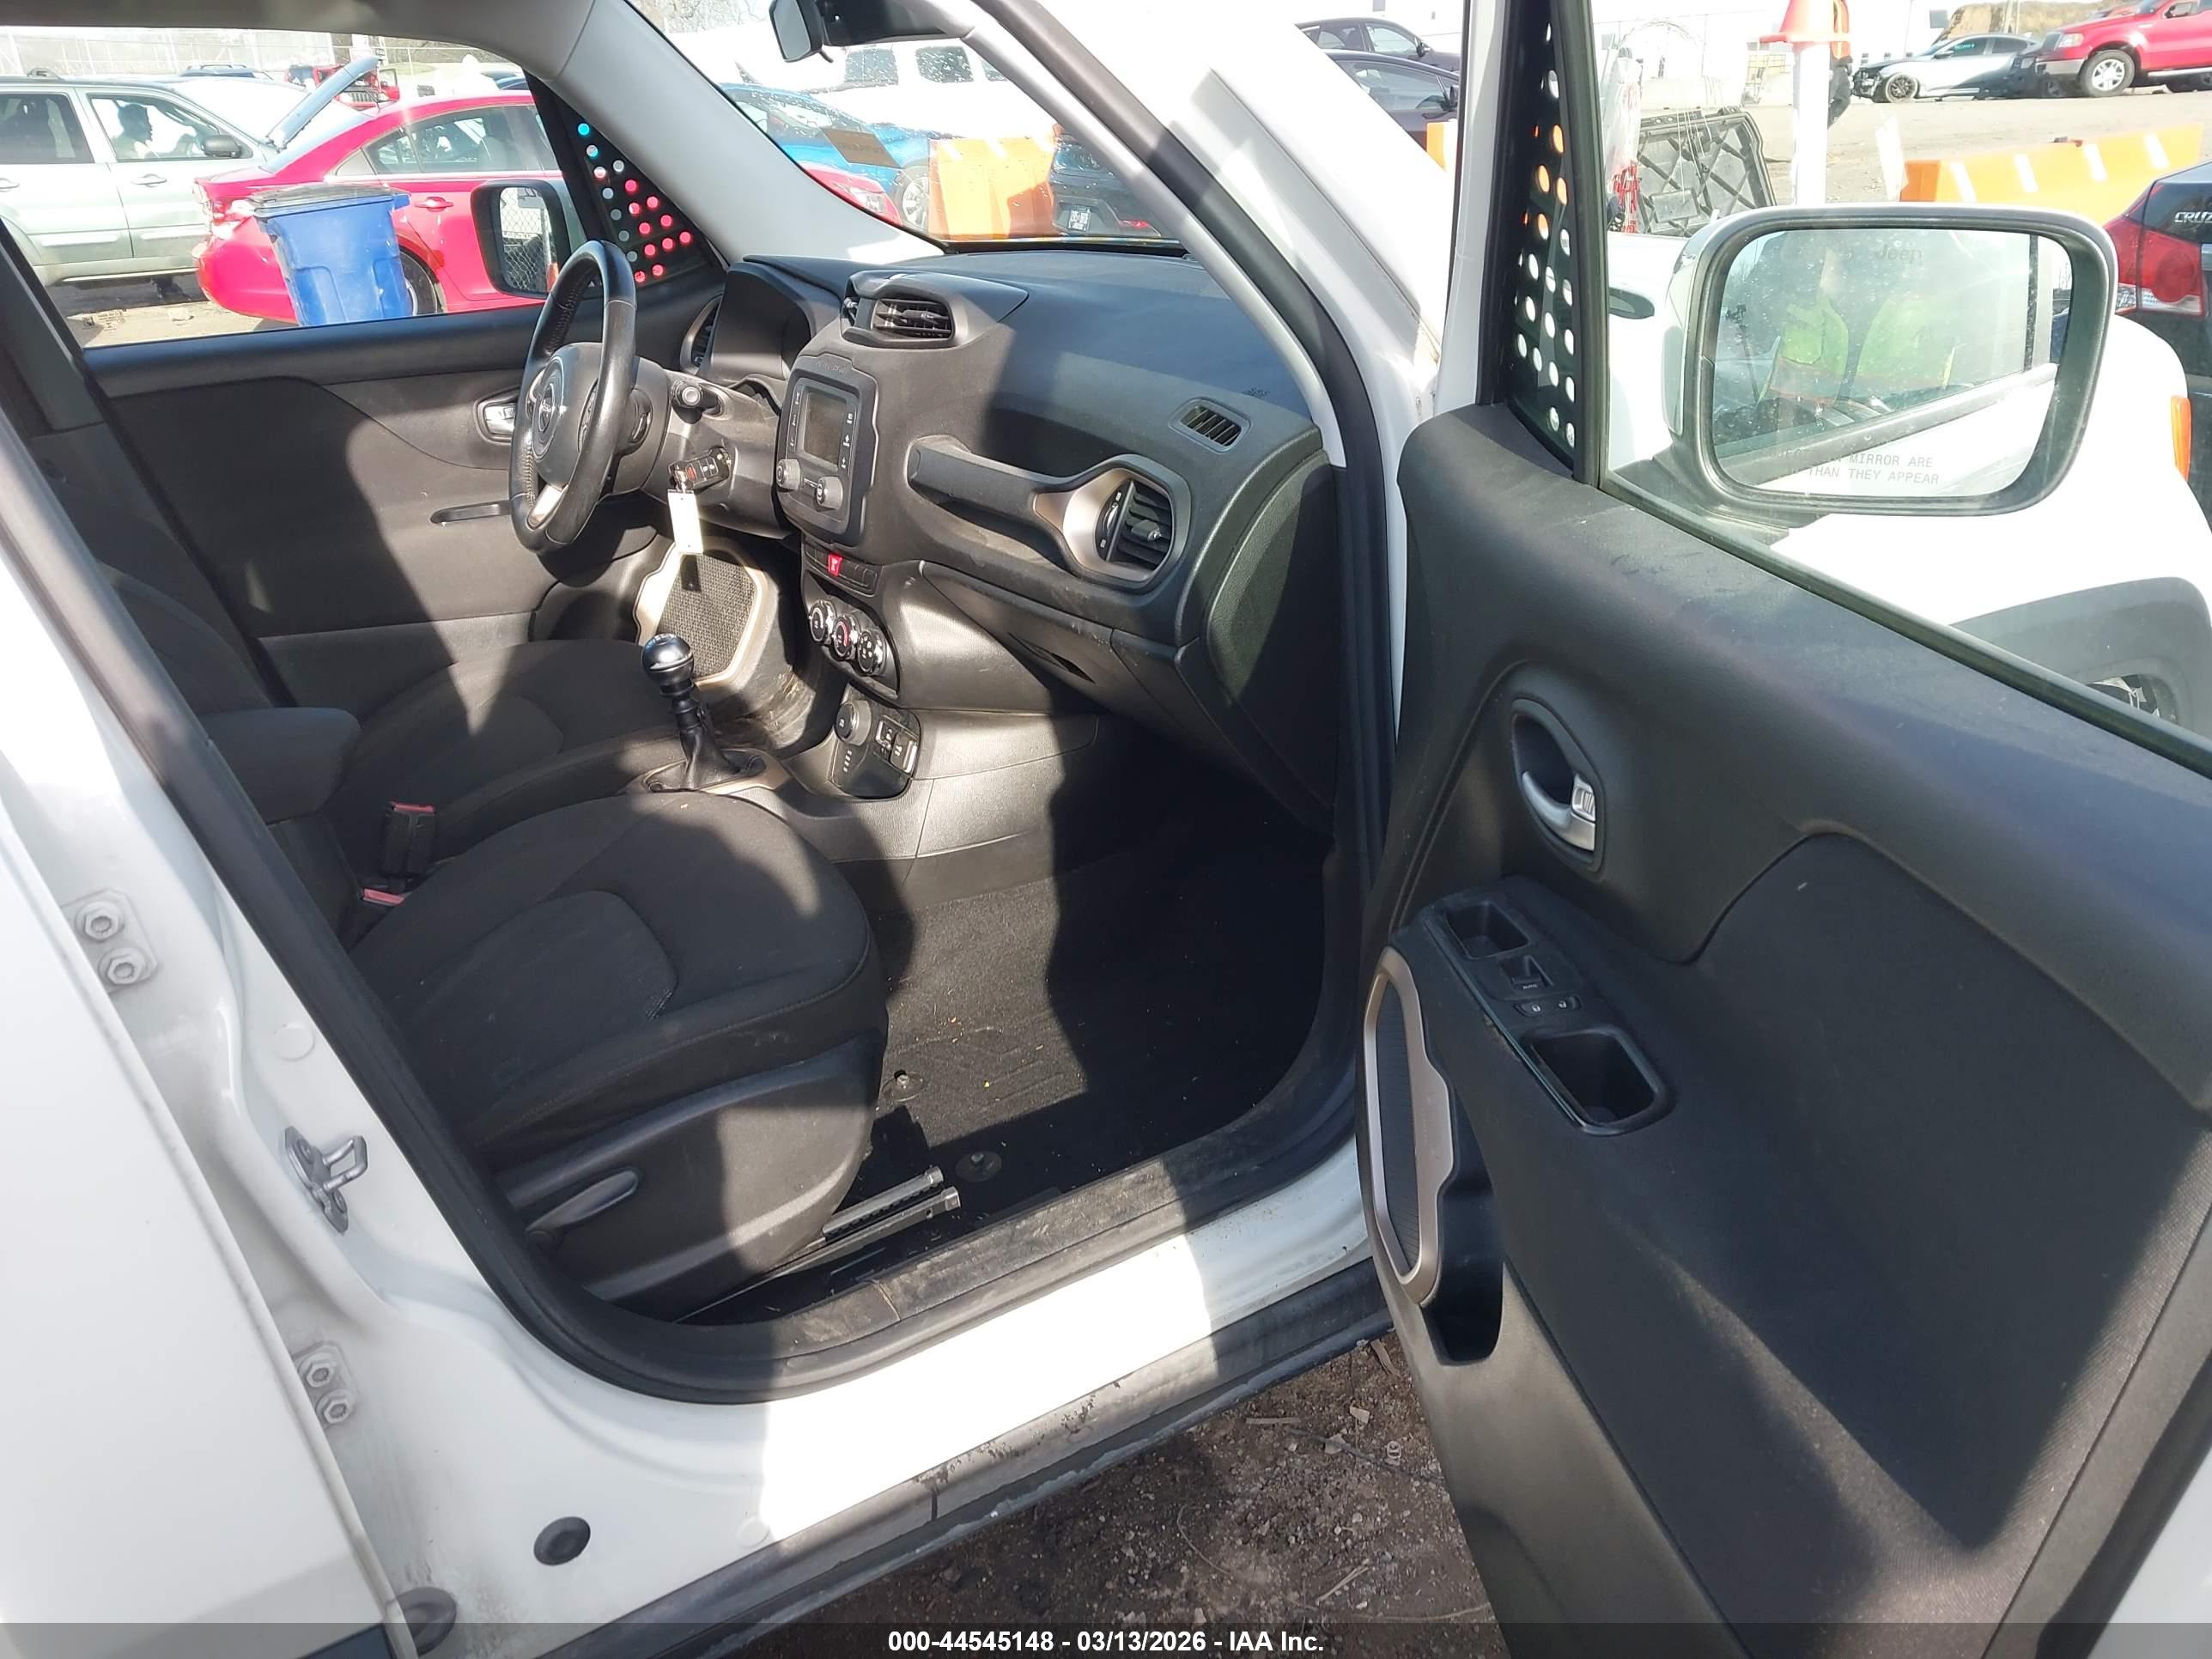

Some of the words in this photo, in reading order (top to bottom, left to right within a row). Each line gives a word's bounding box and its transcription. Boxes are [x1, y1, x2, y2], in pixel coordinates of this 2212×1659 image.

[1875, 244, 1923, 264] Jeep
[1849, 453, 1900, 466] MIRROR
[1907, 456, 1934, 468] ARE
[1808, 466, 1840, 477] THAN
[1848, 468, 1881, 480] THEY
[1887, 471, 1940, 484] APPEAR
